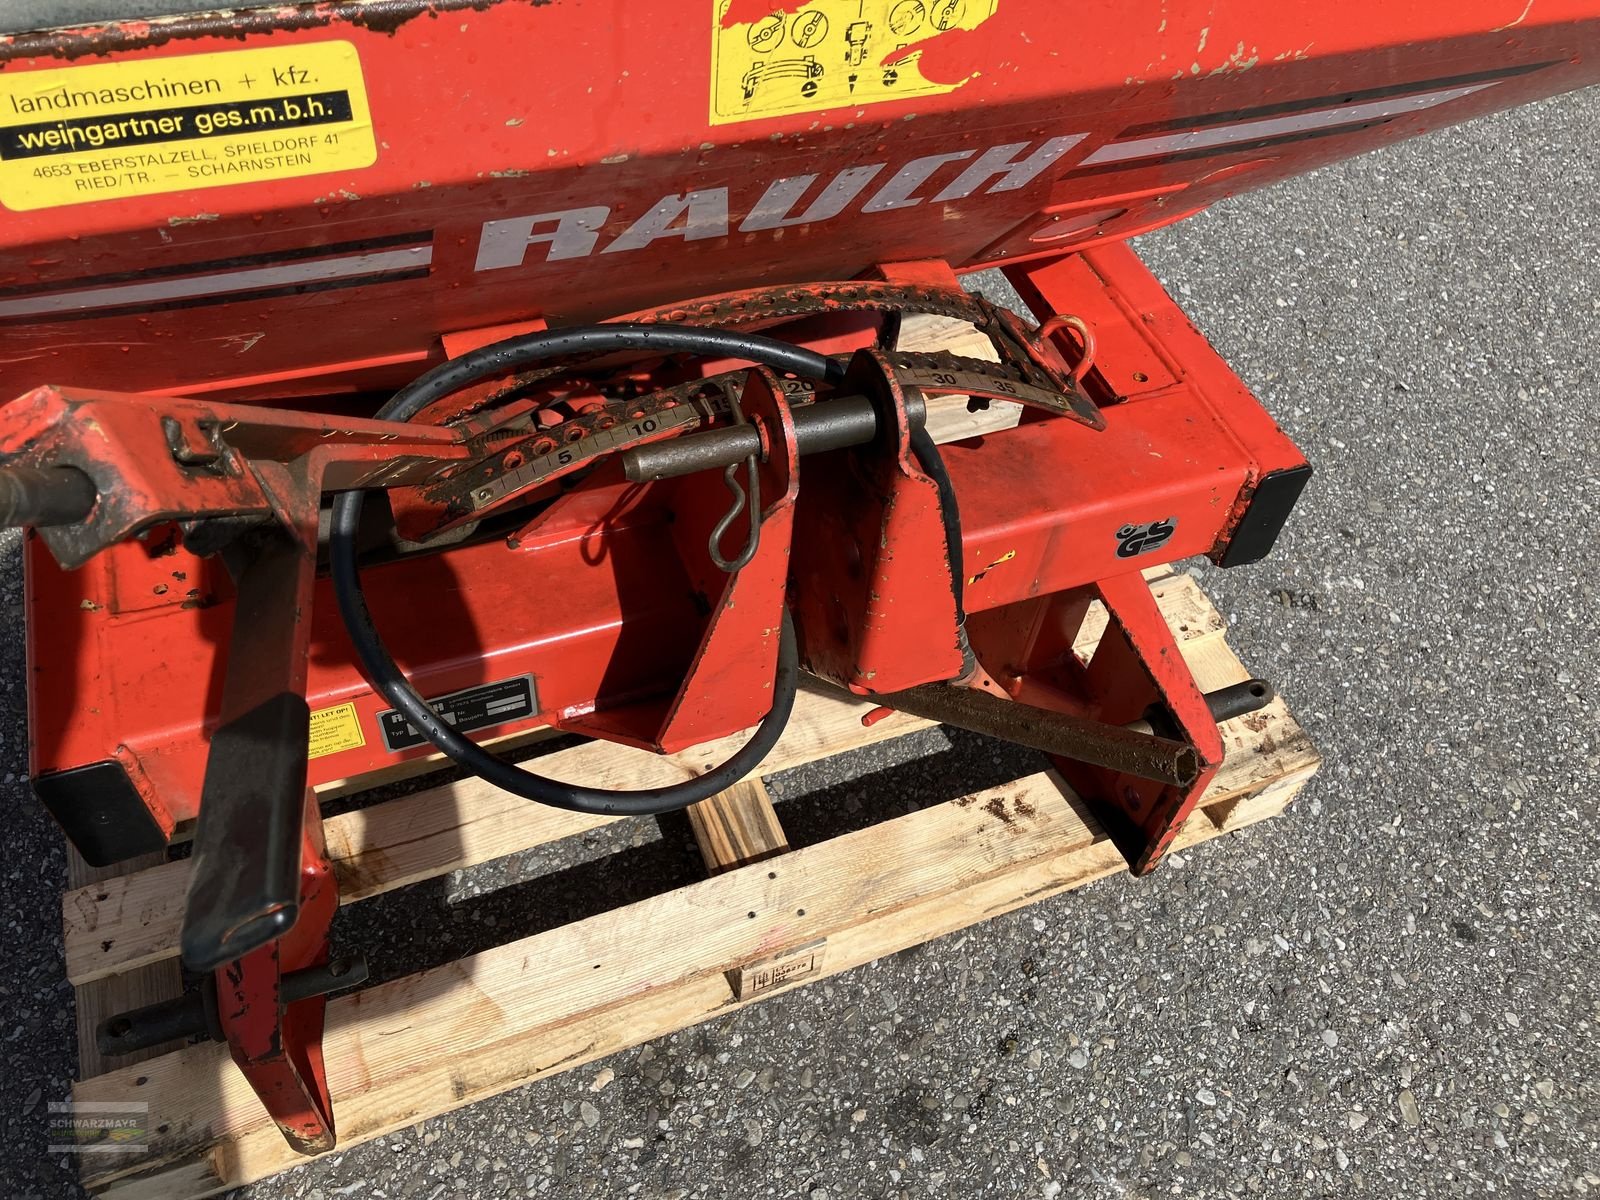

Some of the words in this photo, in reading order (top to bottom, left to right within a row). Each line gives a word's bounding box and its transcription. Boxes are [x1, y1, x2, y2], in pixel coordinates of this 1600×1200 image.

[10, 78, 221, 114] landmaschinen
[238, 73, 256, 89] +
[272, 65, 319, 87] kfz.
[18, 116, 184, 150] weingartner
[195, 97, 333, 134] ges.m.b.h.
[33, 164, 72, 179] 4653
[78, 148, 218, 174] EBERSTALZELL,
[224, 136, 319, 158] SPIELDORF
[324, 133, 339, 145] 41
[75, 172, 156, 191] RIED/TR.
[187, 153, 312, 178] SCHARNSTEIN
[474, 133, 1090, 271] RAUCH
[933, 373, 957, 385] 30
[996, 380, 1015, 394] 35
[557, 450, 573, 465] 5
[630, 419, 658, 437] 10
[787, 380, 815, 395] 20
[391, 729, 404, 737] Typ
